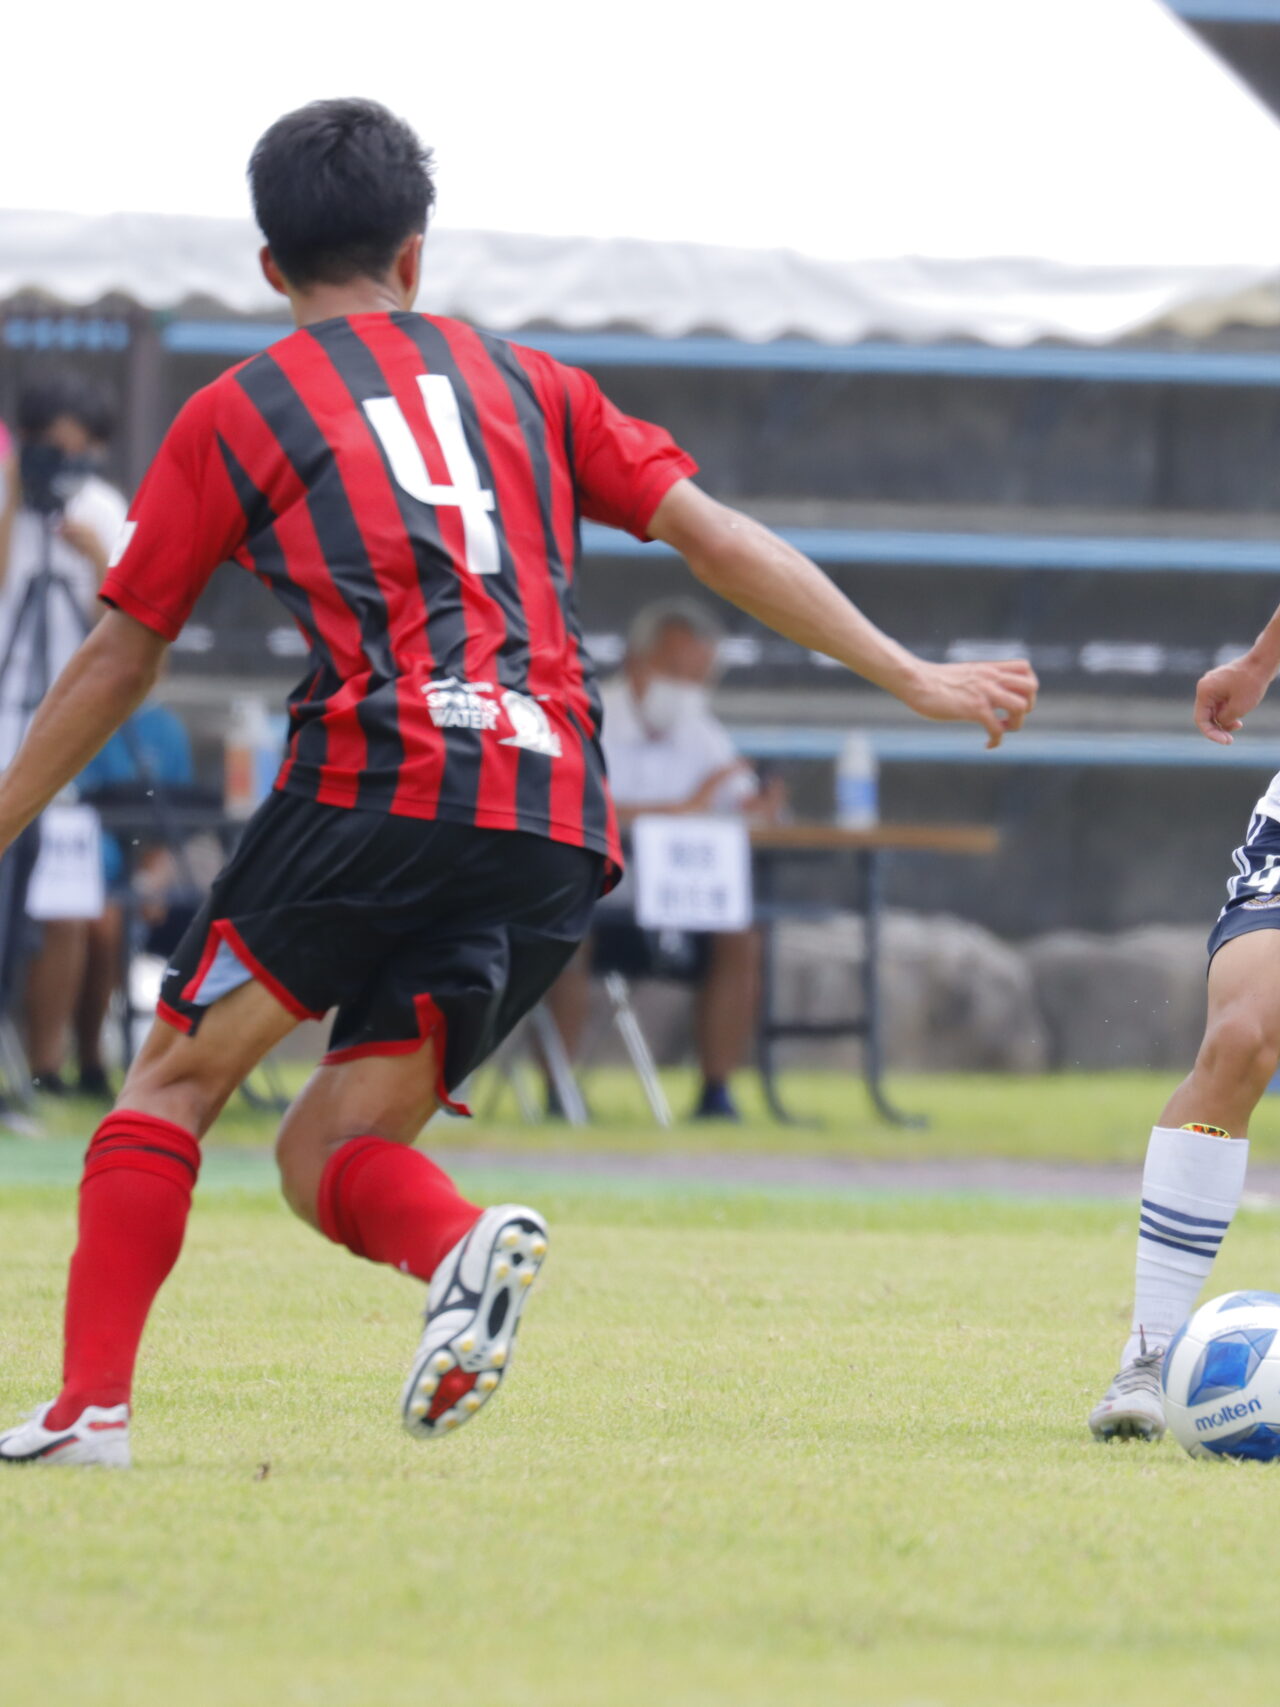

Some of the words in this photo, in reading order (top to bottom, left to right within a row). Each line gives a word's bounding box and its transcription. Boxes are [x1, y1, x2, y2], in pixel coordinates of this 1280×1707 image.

[361, 374, 501, 575] 4
[428, 706, 498, 731] WATER
[1195, 1397, 1262, 1431] molten
